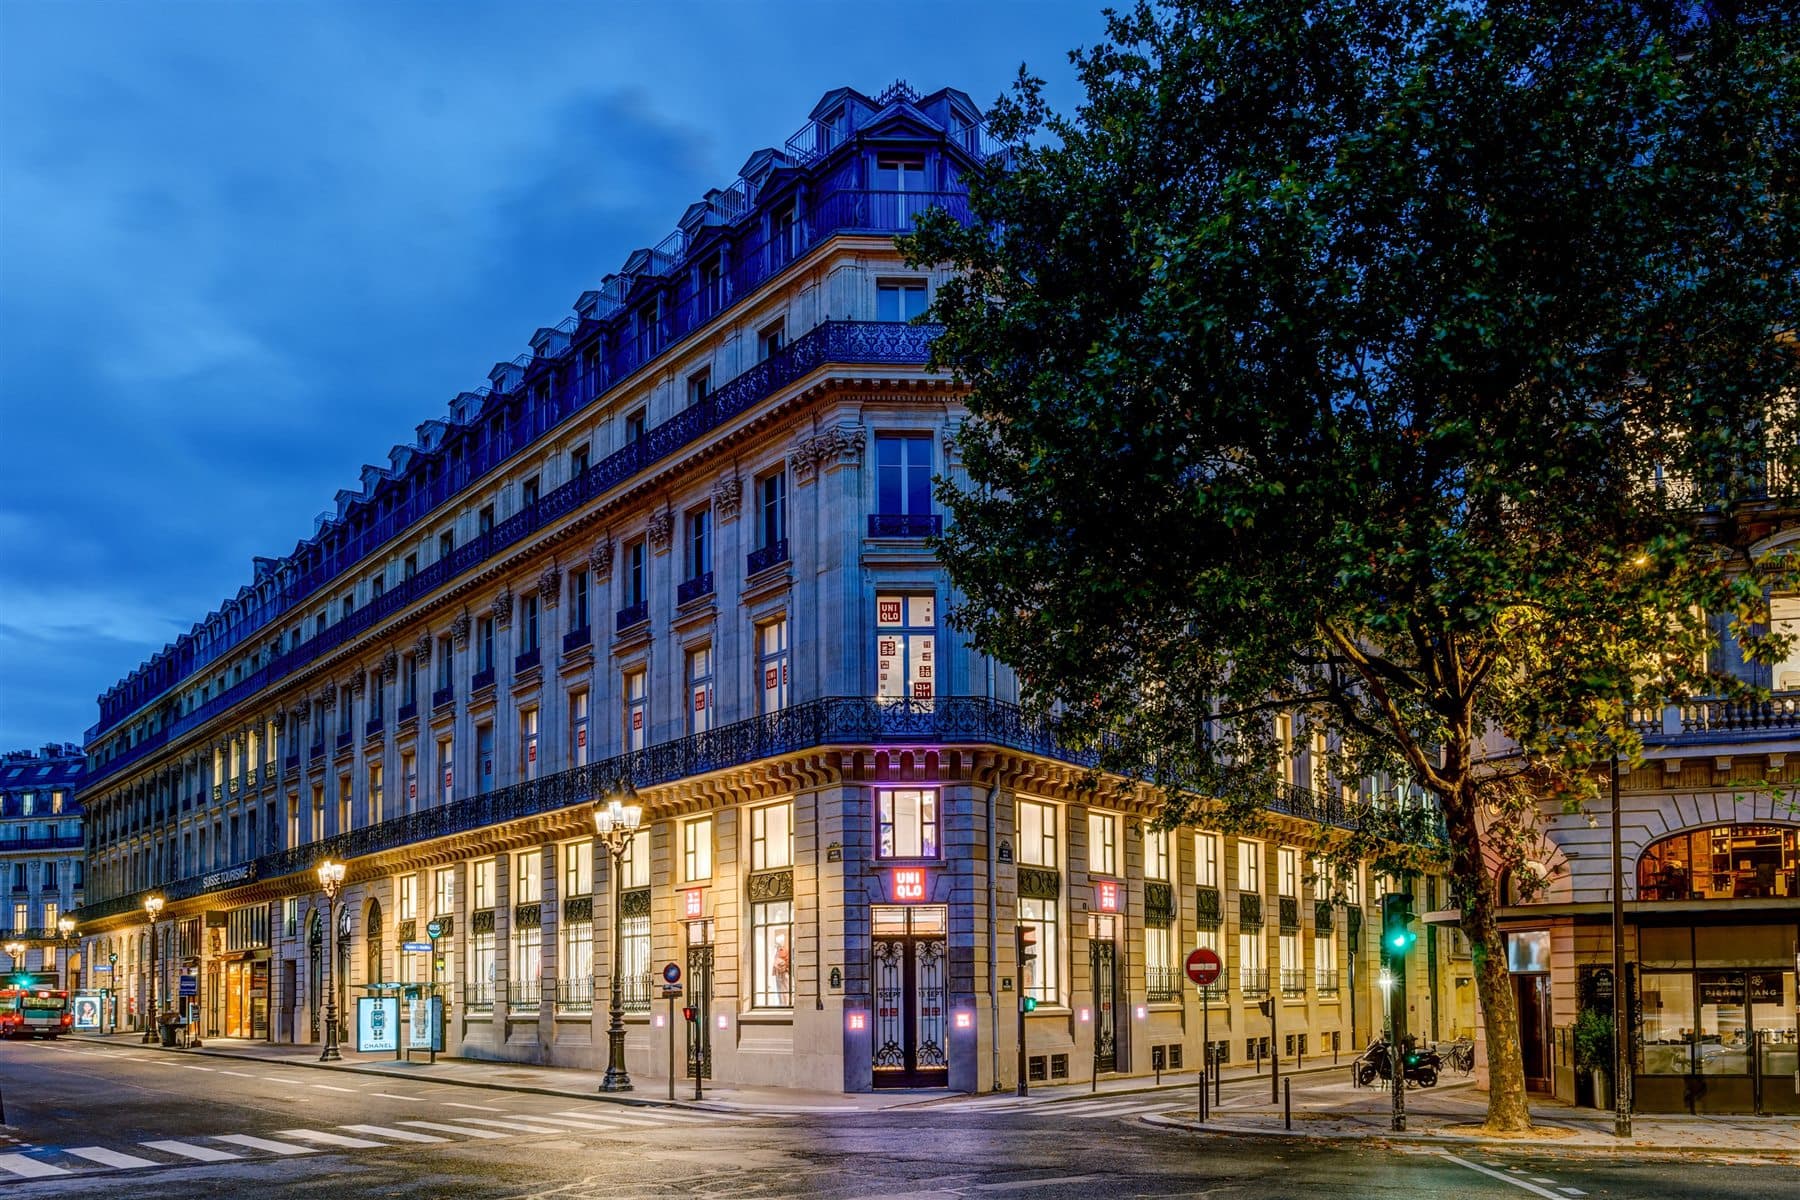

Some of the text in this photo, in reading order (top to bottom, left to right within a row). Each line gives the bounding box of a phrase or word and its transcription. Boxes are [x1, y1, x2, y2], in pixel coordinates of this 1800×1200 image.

[881, 604, 897, 612] UNI
[881, 612, 898, 621] QLO
[896, 872, 920, 884] UNI
[896, 885, 922, 899] QLO
[1705, 989, 1744, 997] PIERRE
